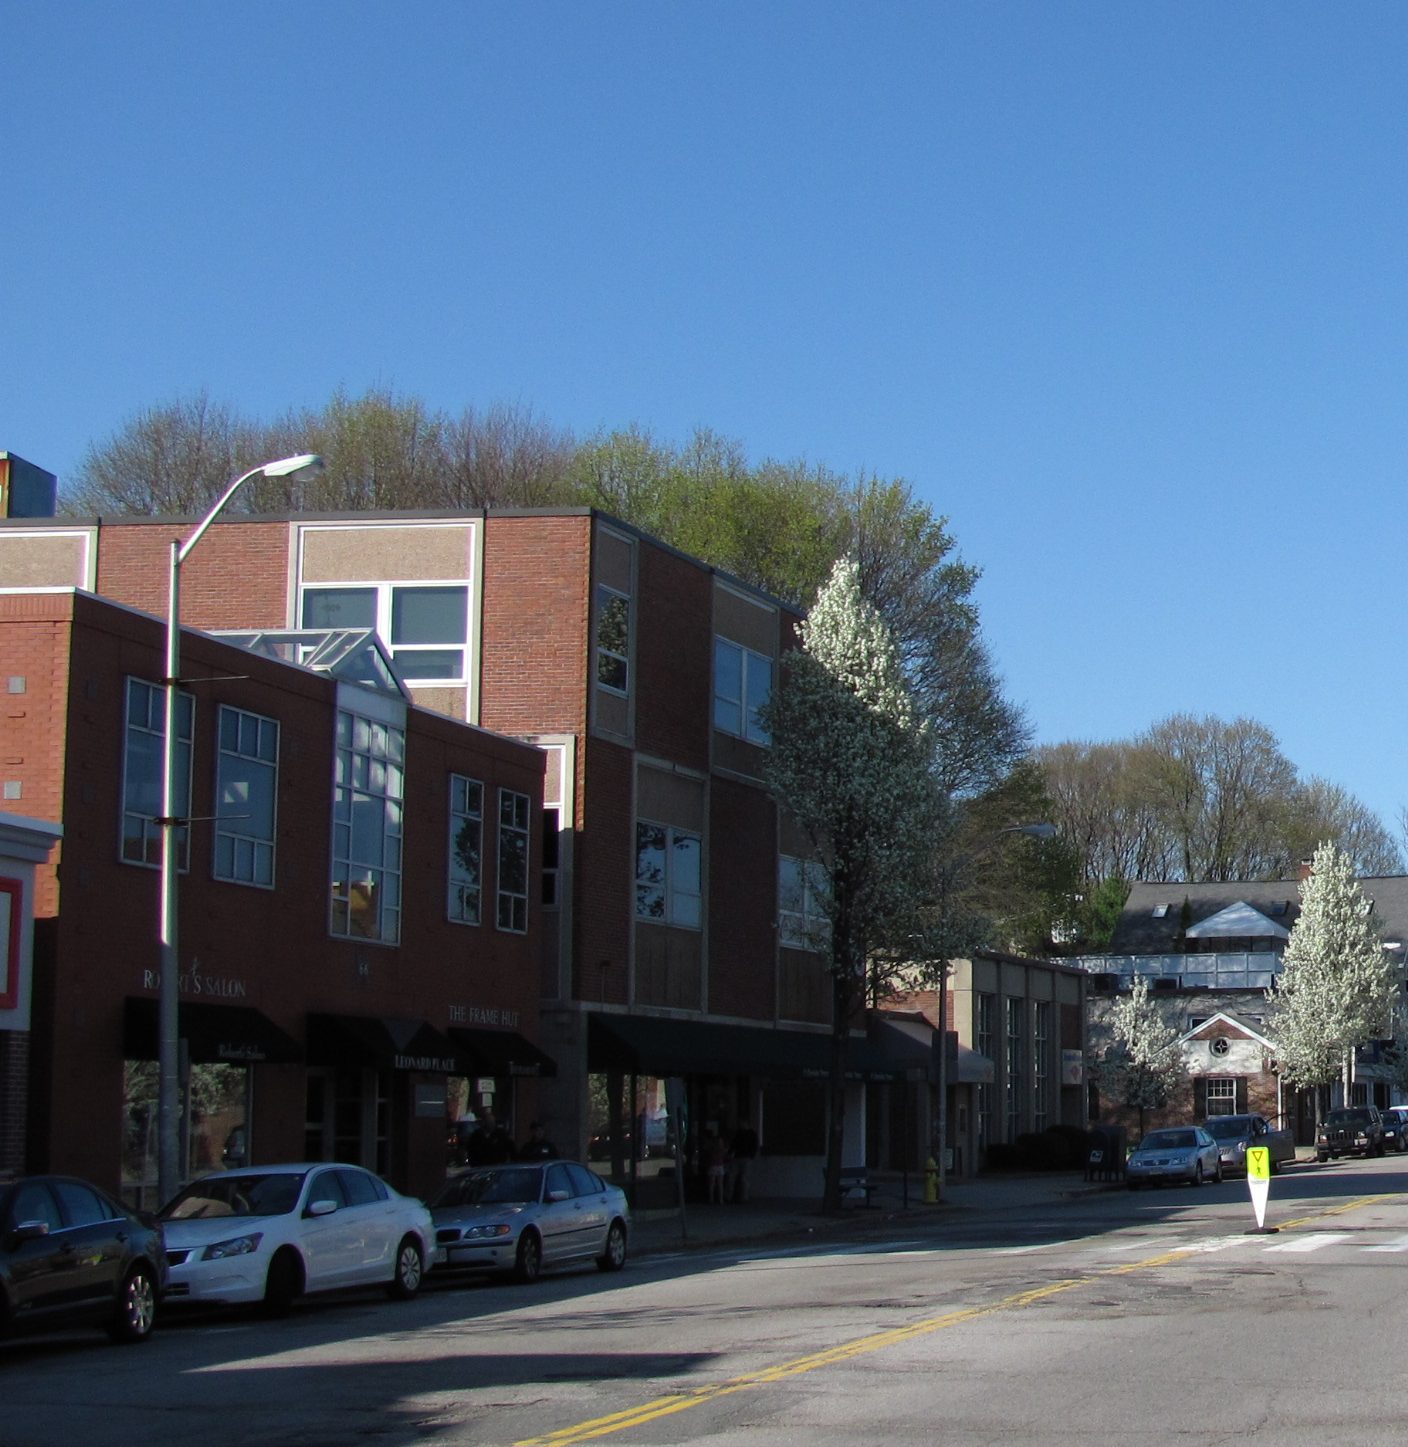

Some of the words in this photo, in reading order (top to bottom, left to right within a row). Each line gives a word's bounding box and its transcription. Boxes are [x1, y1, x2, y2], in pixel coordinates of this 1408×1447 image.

[206, 975, 246, 998] SALON
[449, 1005, 466, 1022] THE
[469, 1007, 499, 1026] FRAME
[501, 1010, 520, 1028] HUT
[394, 1054, 432, 1071] LEONARD
[432, 1057, 457, 1073] PLACE
